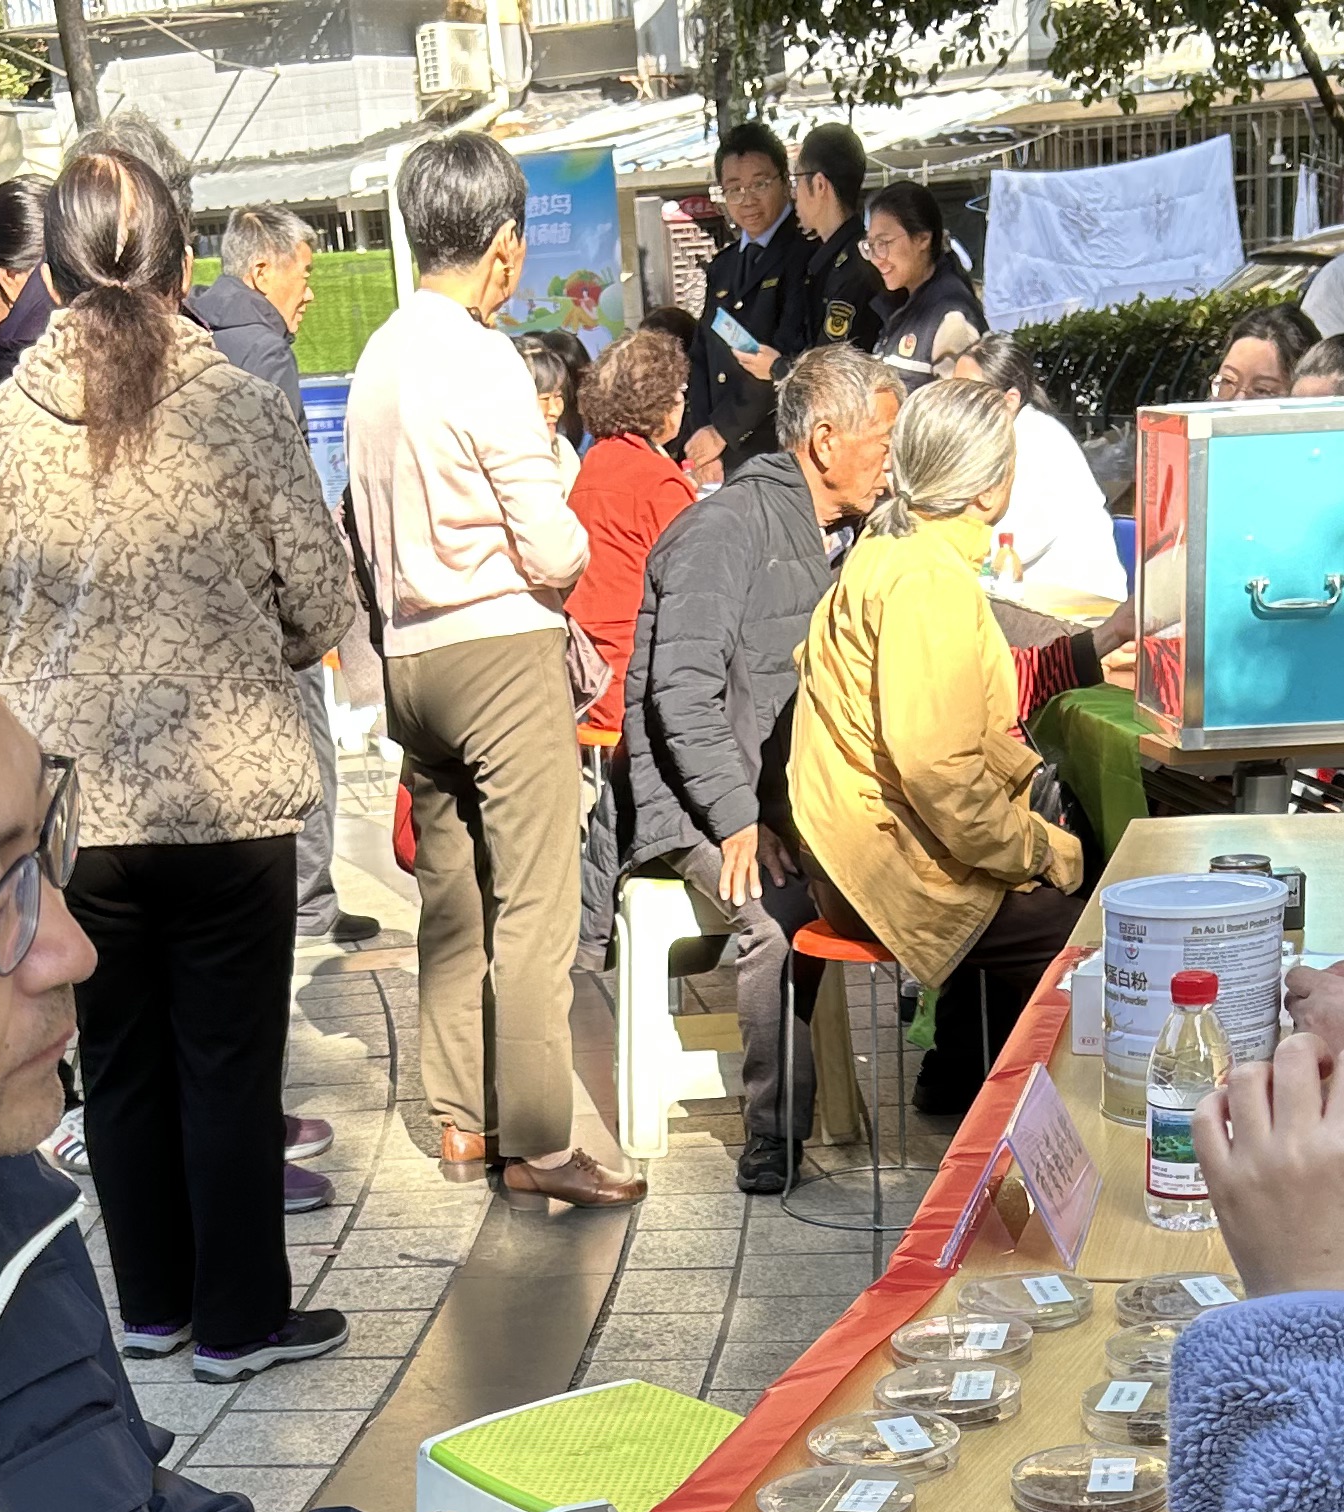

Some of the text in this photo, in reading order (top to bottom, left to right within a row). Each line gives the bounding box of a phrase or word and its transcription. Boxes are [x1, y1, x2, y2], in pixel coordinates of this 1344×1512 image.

[1119, 922, 1147, 936] 白云山
[1105, 962, 1148, 992] 蛋白粉
